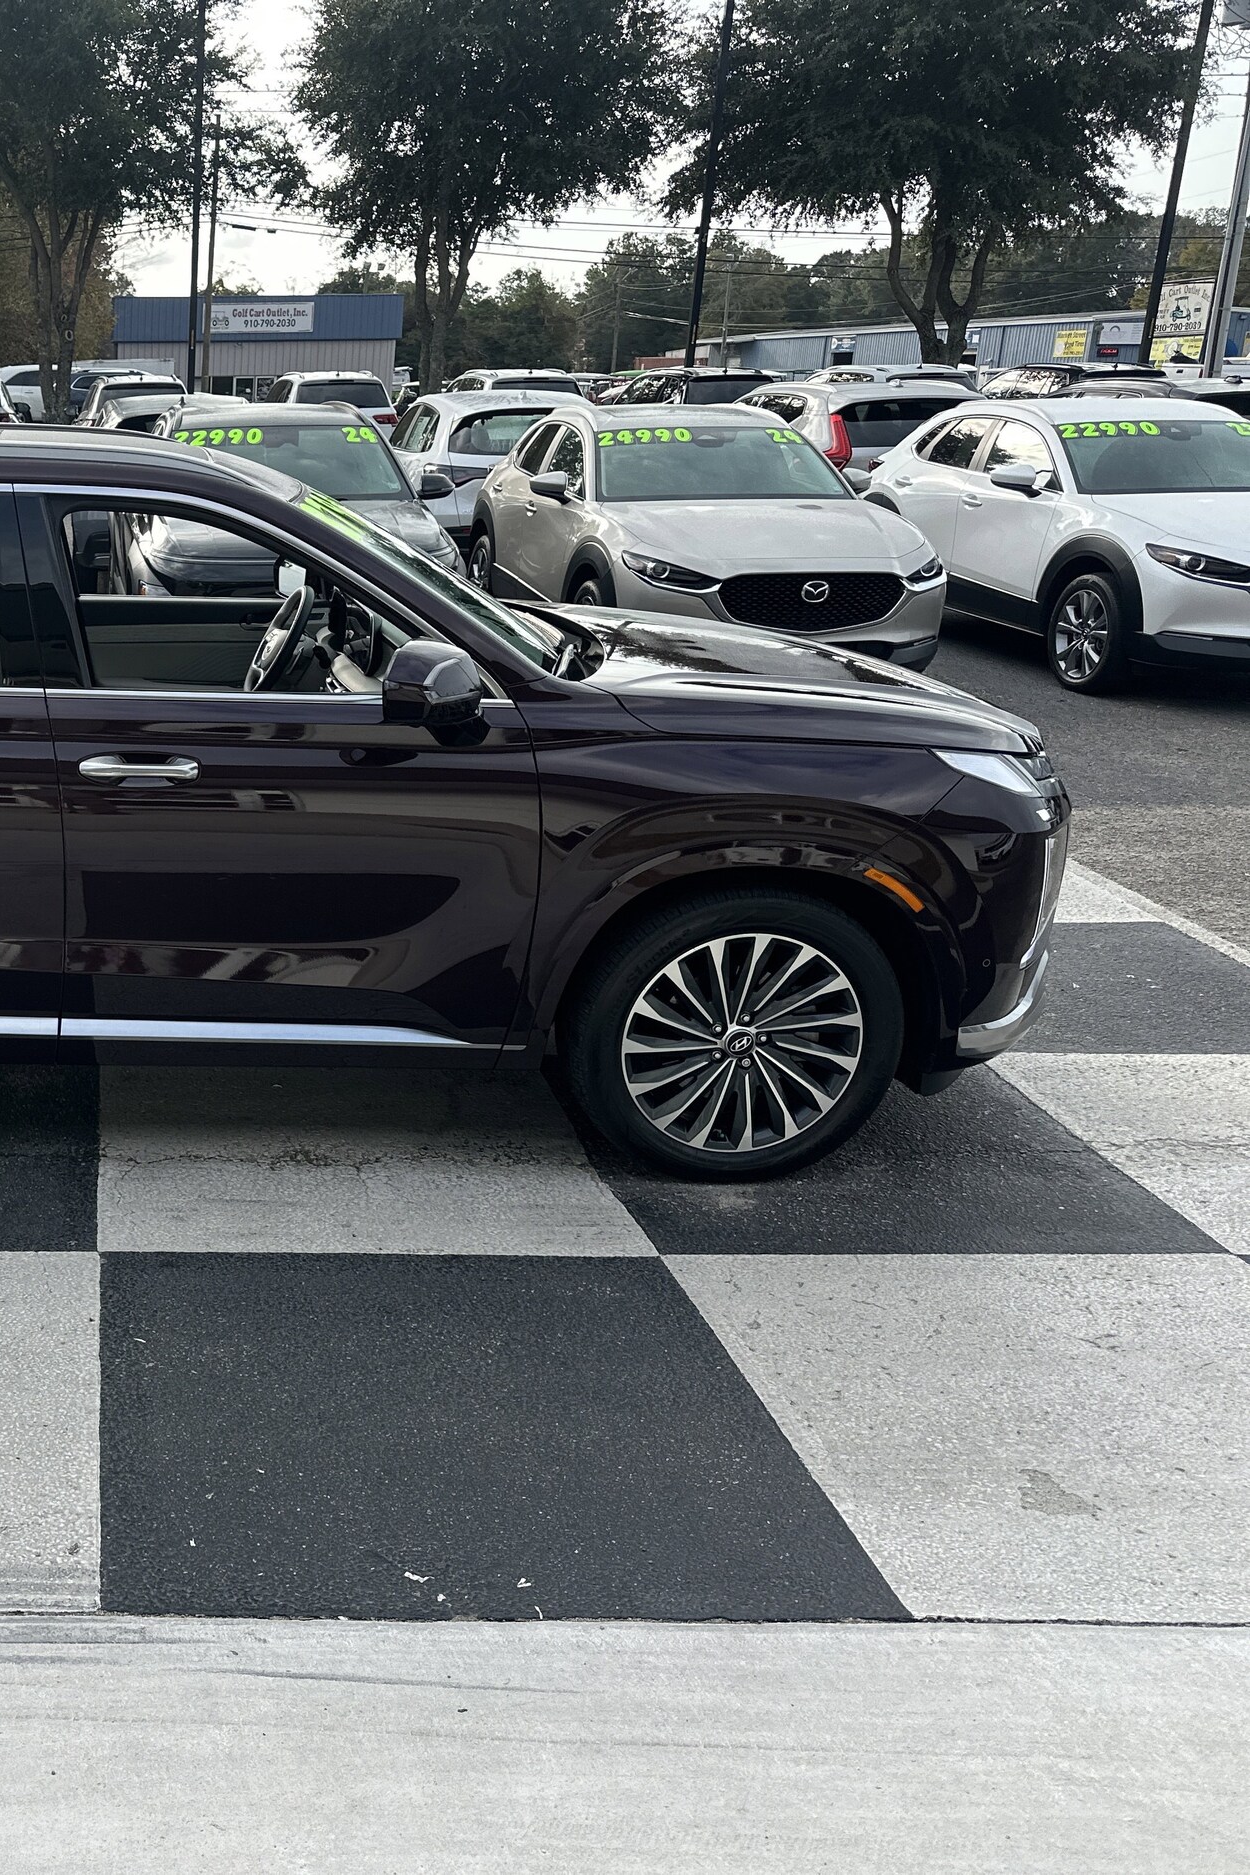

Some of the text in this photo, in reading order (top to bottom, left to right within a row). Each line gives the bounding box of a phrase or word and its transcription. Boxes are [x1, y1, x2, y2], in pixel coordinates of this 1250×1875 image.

[232, 309, 248, 317] Golf
[249, 308, 265, 317] Cart
[244, 319, 296, 328] 910-790-2030
[174, 428, 263, 446] 22990
[342, 427, 377, 443] 24
[598, 428, 692, 446] 24990
[766, 429, 804, 444] 24
[1059, 421, 1161, 438] 22990
